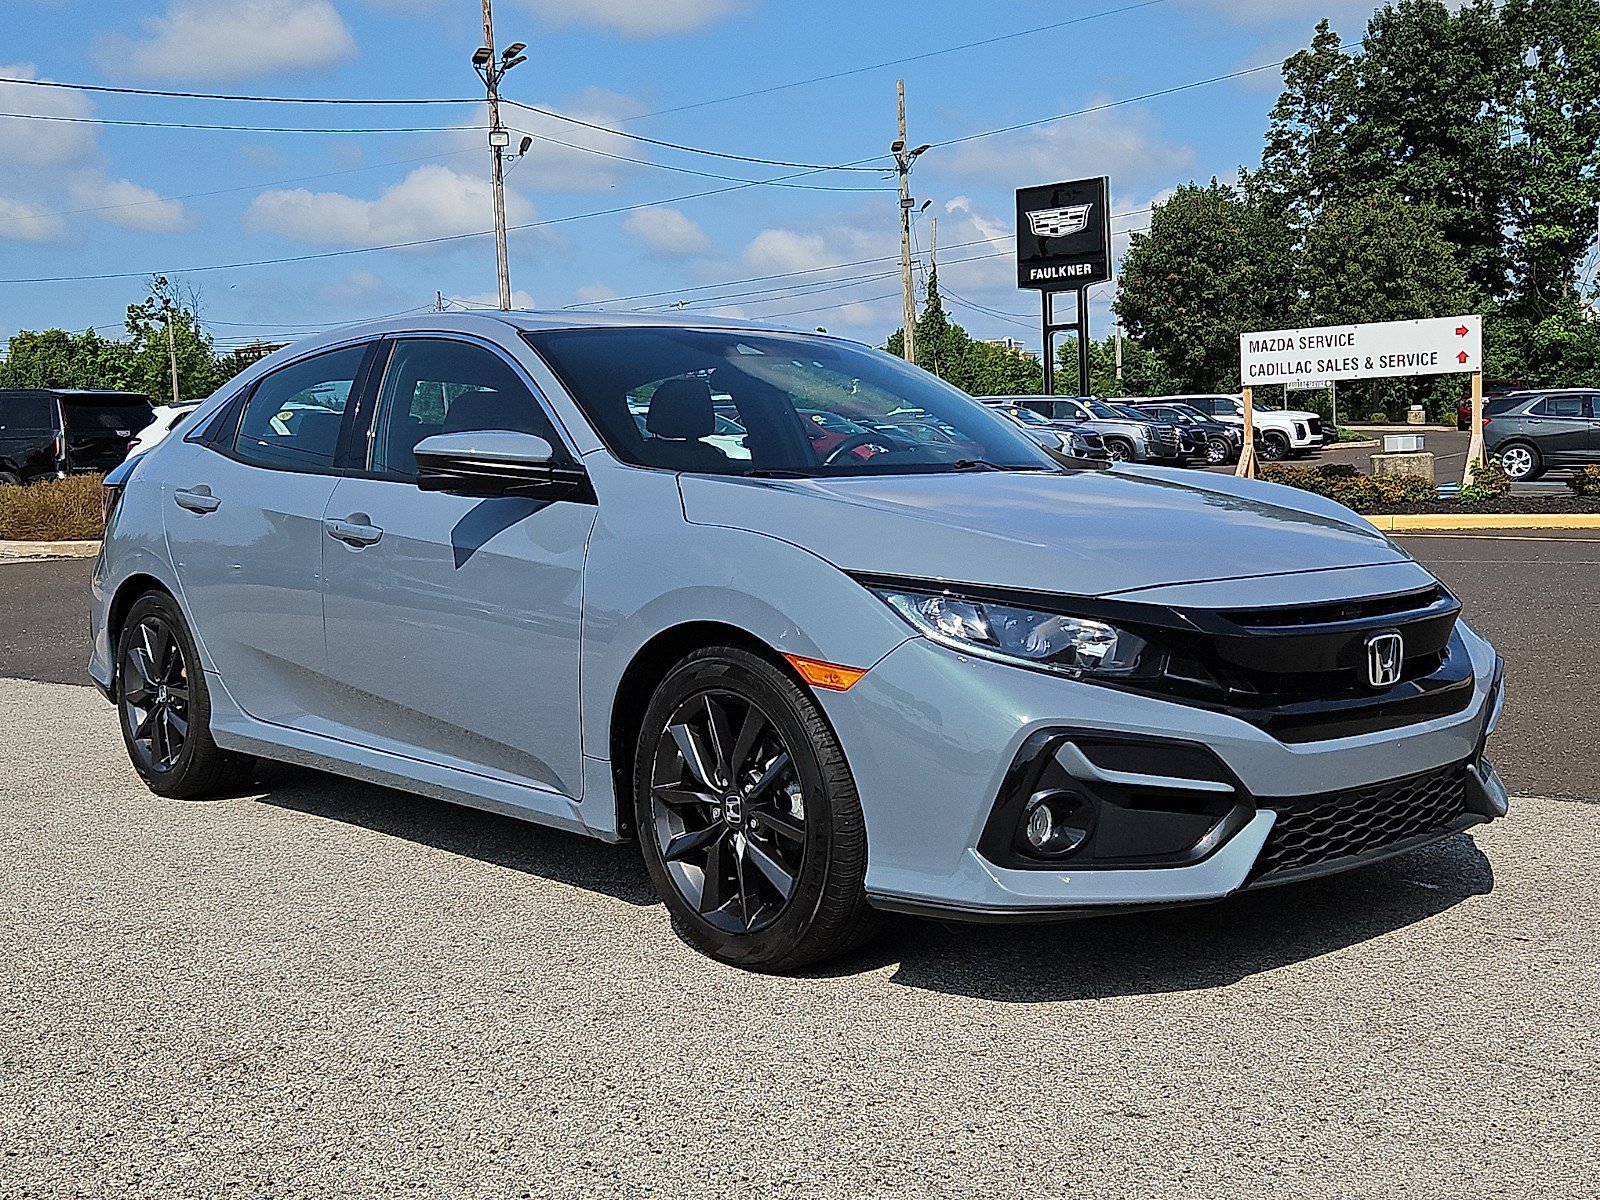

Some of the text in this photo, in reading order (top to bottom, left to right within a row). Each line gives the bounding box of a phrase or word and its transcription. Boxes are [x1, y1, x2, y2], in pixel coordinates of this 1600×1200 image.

[1030, 263, 1092, 280] FAULKNER
[1249, 333, 1355, 353] MAZDA SERVICE
[1249, 352, 1438, 377] CADILLAC SALES & SERVICE
